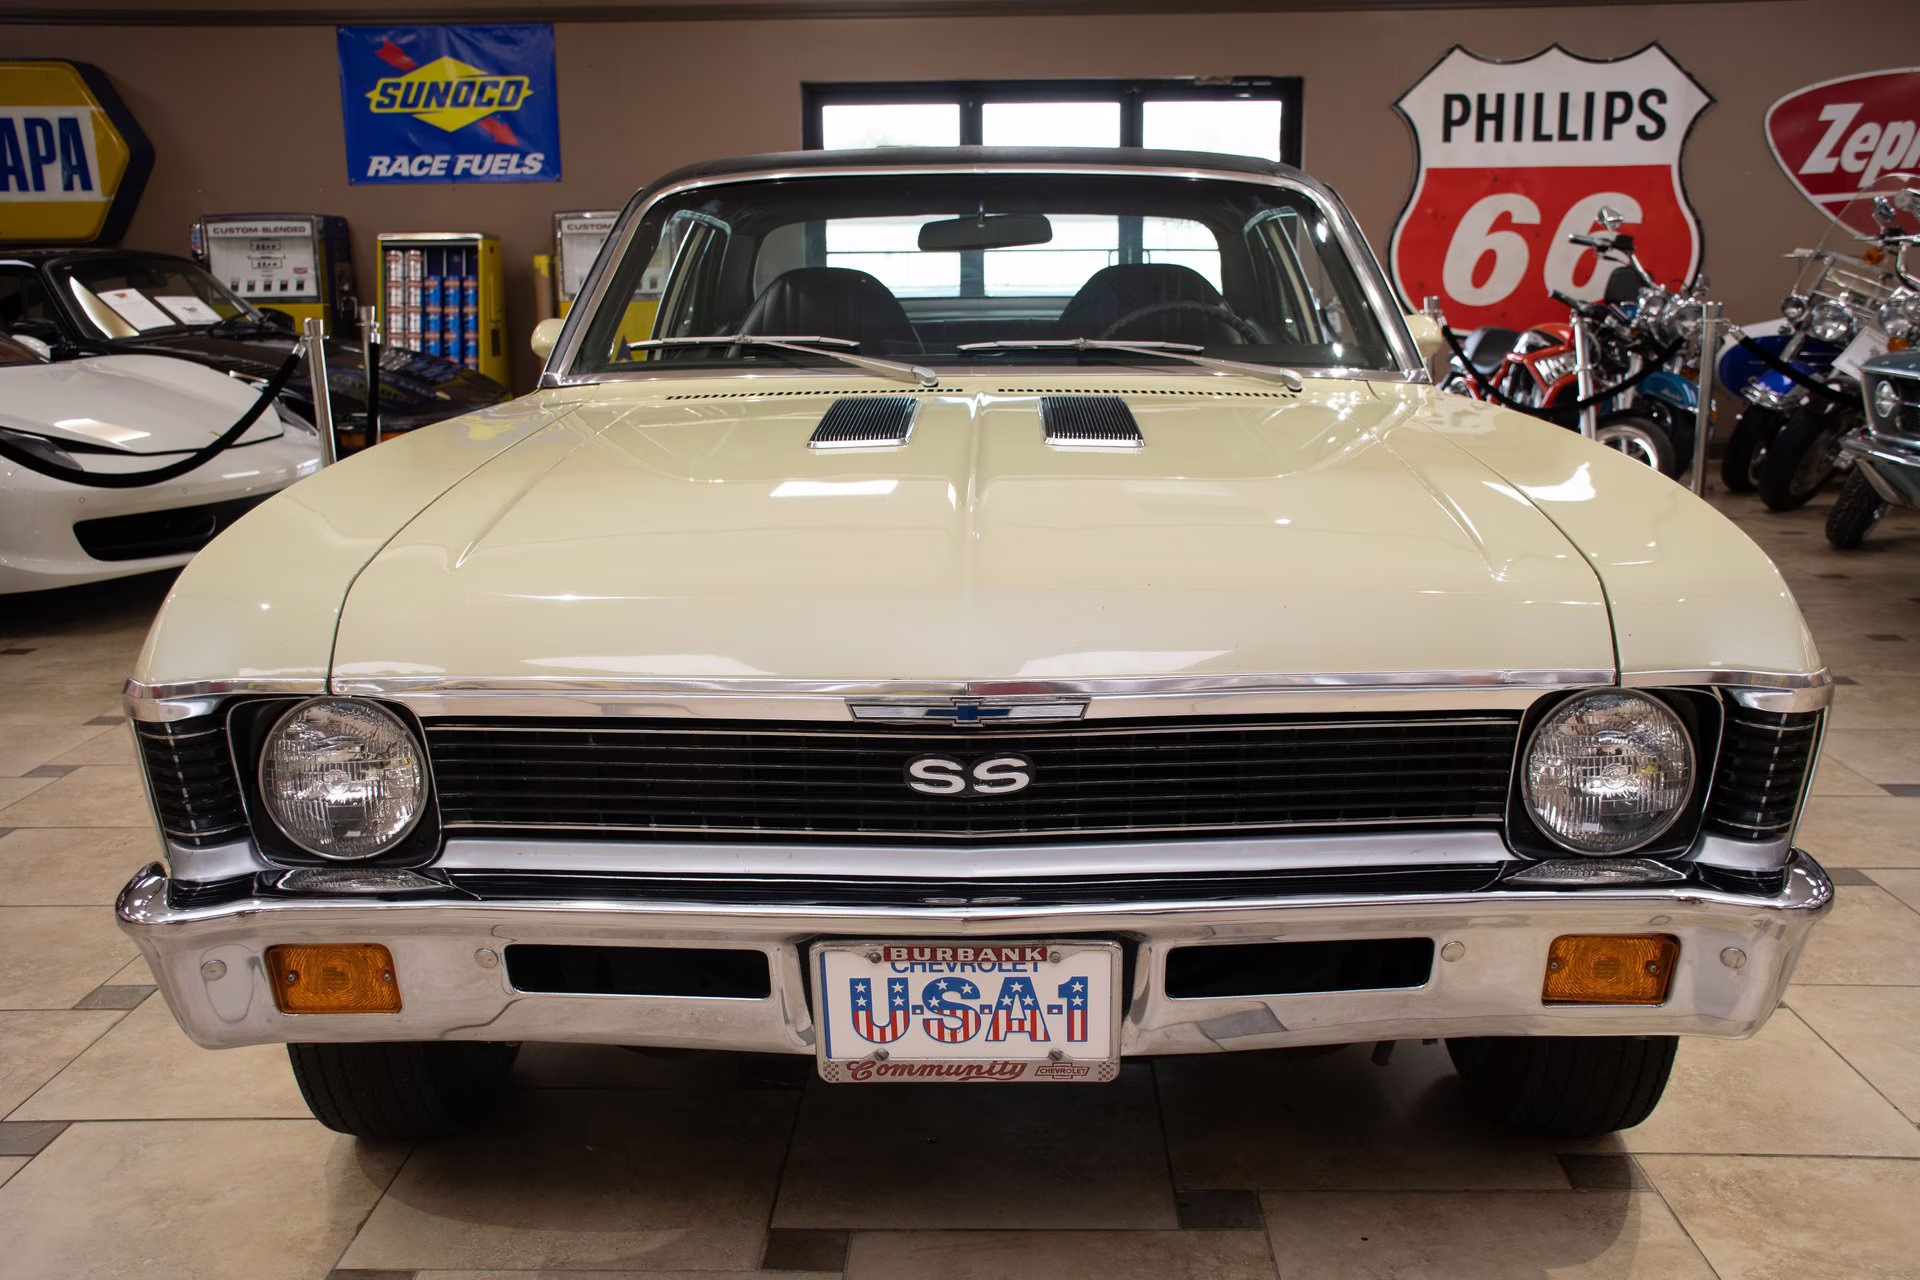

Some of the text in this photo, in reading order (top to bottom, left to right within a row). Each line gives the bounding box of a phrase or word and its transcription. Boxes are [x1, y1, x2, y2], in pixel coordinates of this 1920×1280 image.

[374, 80, 525, 109] SUNOCO
[1442, 88, 1668, 143] PHILLIPS
[0, 117, 94, 193] APA
[366, 152, 545, 177] RACE FUELS
[1442, 191, 1643, 307] 66
[909, 757, 1030, 794] SS
[889, 947, 1043, 961] BURBANK
[846, 1060, 1028, 1082] Community
